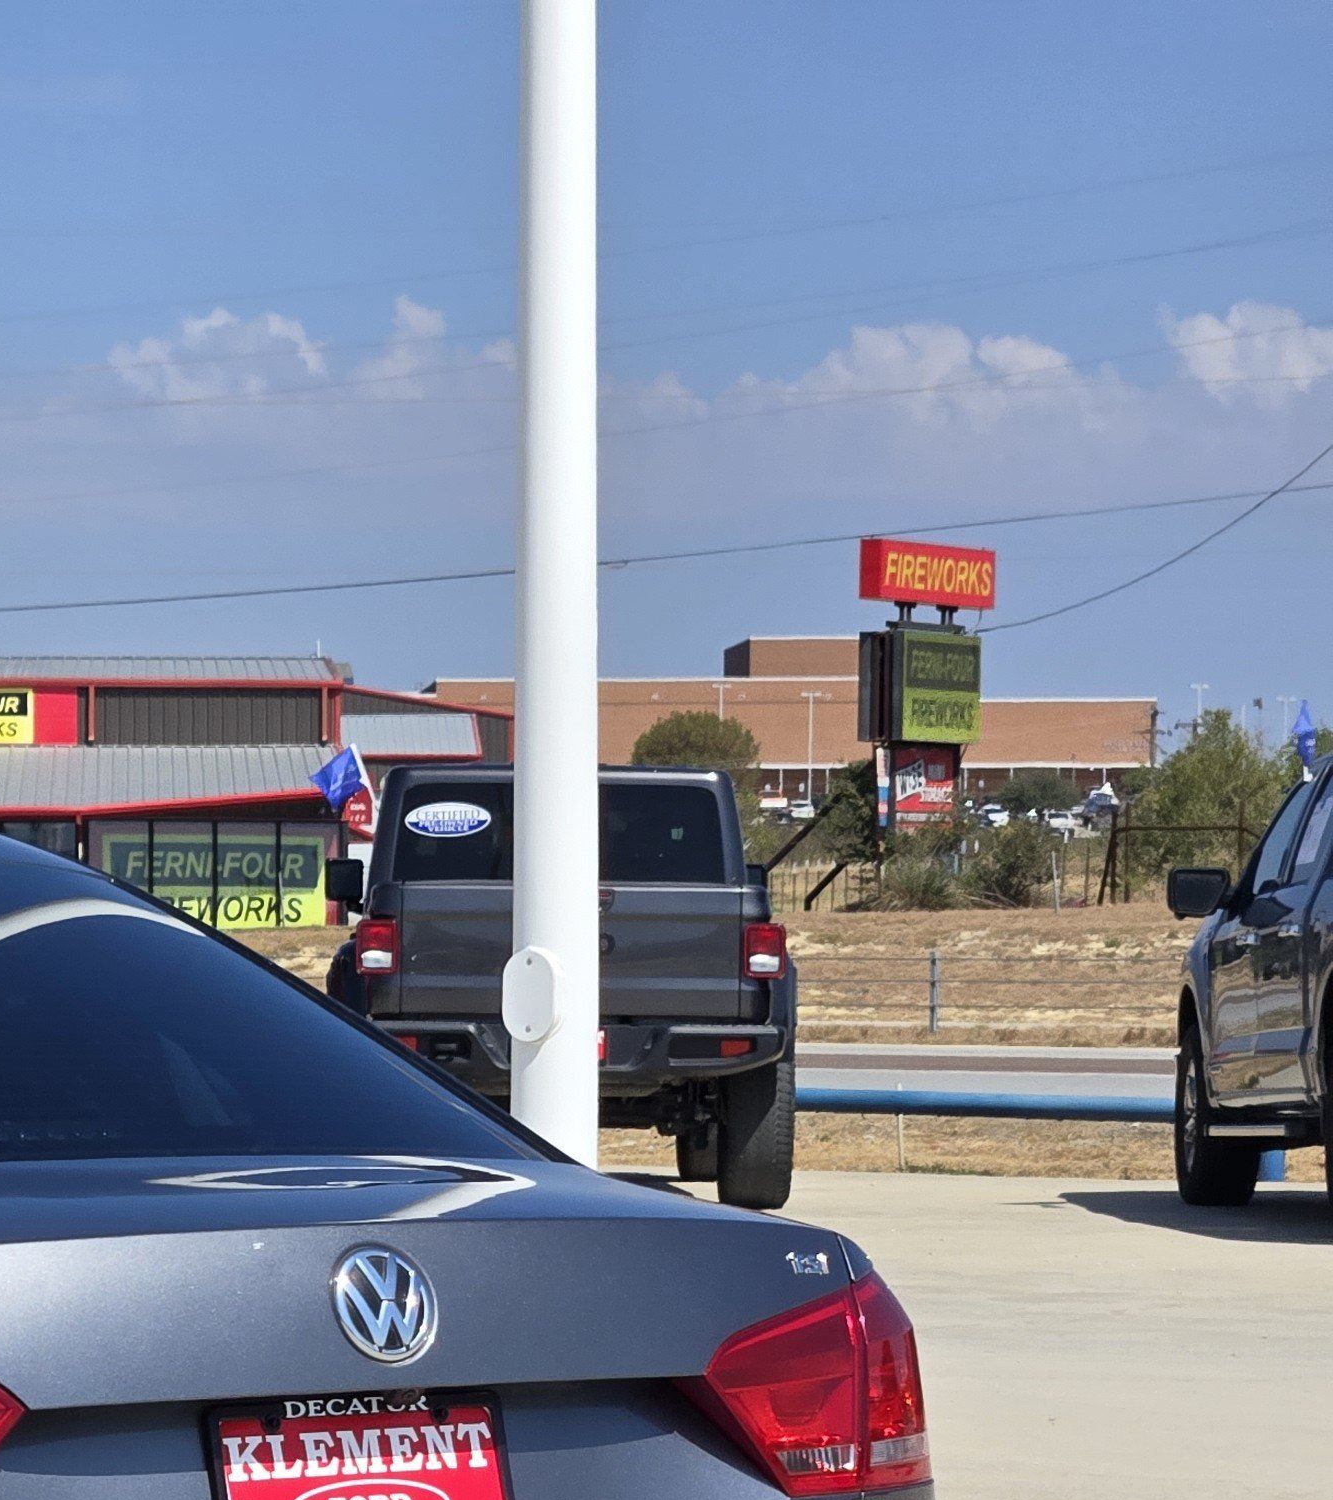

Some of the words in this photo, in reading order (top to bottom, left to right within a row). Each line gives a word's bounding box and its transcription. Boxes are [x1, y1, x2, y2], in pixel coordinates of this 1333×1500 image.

[884, 552, 992, 597] FIREWORKS
[125, 849, 305, 880] FERNI-FOUR
[222, 1422, 492, 1483] KLEMENT
